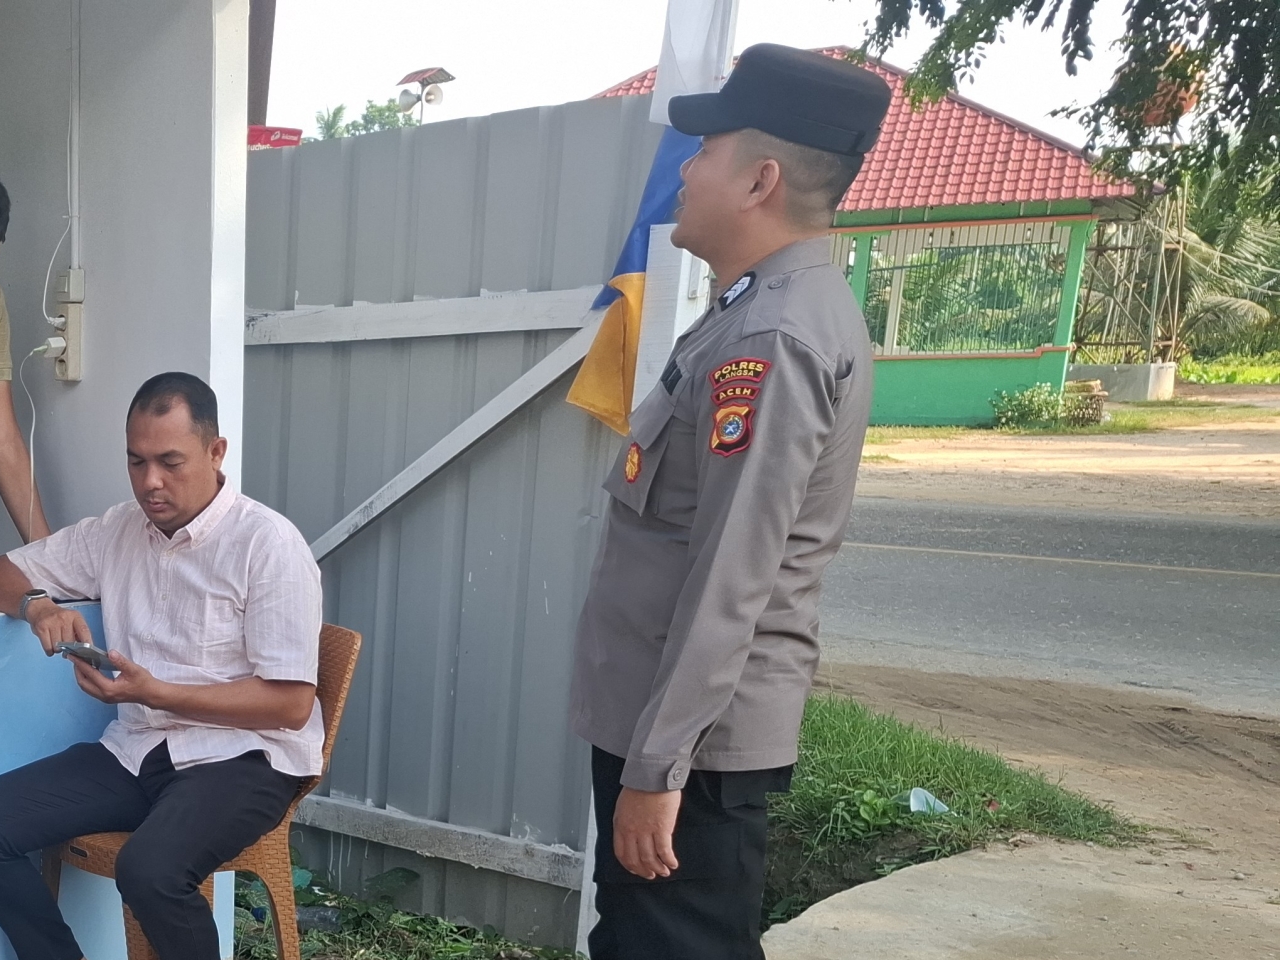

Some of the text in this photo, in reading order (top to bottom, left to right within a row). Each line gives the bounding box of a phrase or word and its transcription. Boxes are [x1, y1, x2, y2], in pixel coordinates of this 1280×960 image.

[714, 361, 765, 380] POLRES
[719, 369, 754, 382] LANGSA
[719, 387, 752, 400] ACEH
